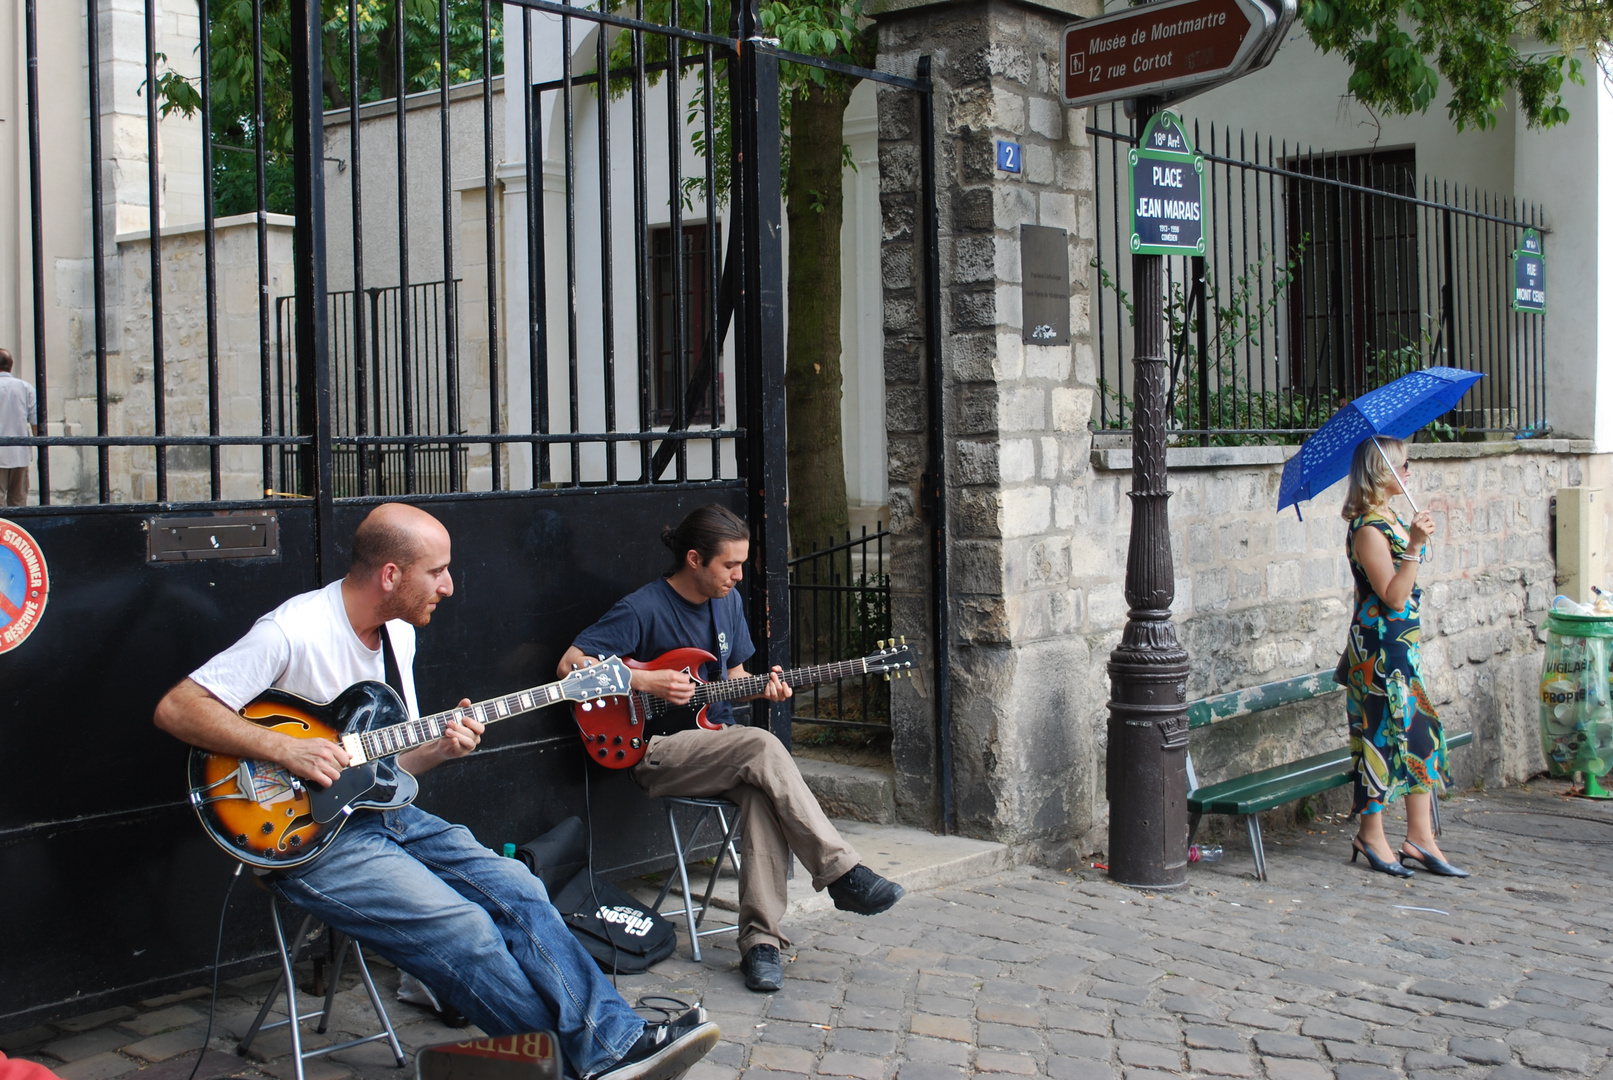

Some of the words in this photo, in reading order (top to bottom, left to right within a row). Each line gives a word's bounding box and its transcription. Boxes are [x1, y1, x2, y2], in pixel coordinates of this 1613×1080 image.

[1089, 34, 1126, 55] Musée
[1131, 28, 1146, 45] de
[1151, 12, 1226, 41] Montmartre
[1088, 65, 1101, 83] 12
[1107, 63, 1126, 79] rue
[1133, 51, 1173, 73] Cortot
[1005, 146, 1014, 168] 2
[1152, 166, 1182, 188] PLACE
[1136, 198, 1161, 218] JEAN
[1163, 199, 1200, 221] MARAIS
[1526, 263, 1537, 276] RUE
[1516, 287, 1531, 301] MONT
[3, 529, 42, 588] STATIONNER
[3, 600, 39, 643] RÉSERVÉ
[595, 906, 654, 936] Gibson
